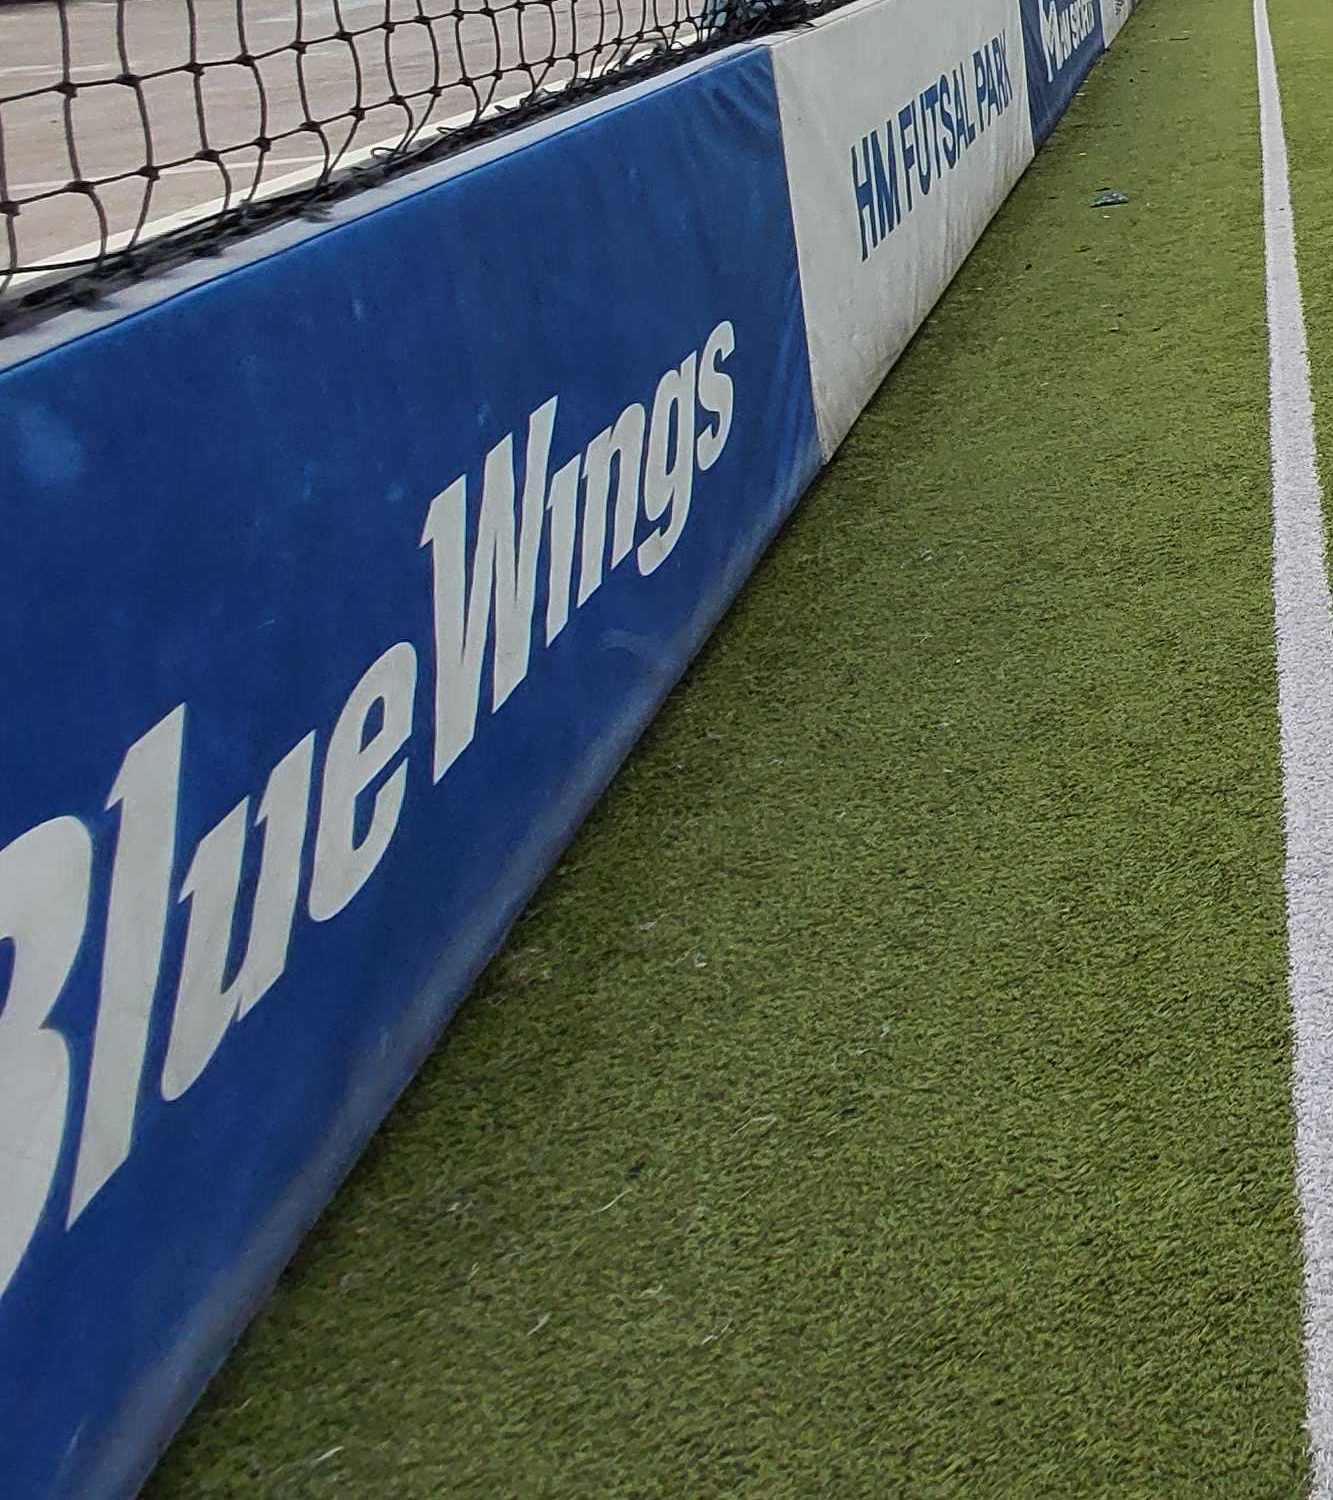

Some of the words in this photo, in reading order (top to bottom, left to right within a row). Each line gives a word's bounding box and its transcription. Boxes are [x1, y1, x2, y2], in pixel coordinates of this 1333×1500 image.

[851, 119, 901, 263] HM
[897, 61, 977, 213] FUTSAL
[972, 28, 1014, 134] PARK
